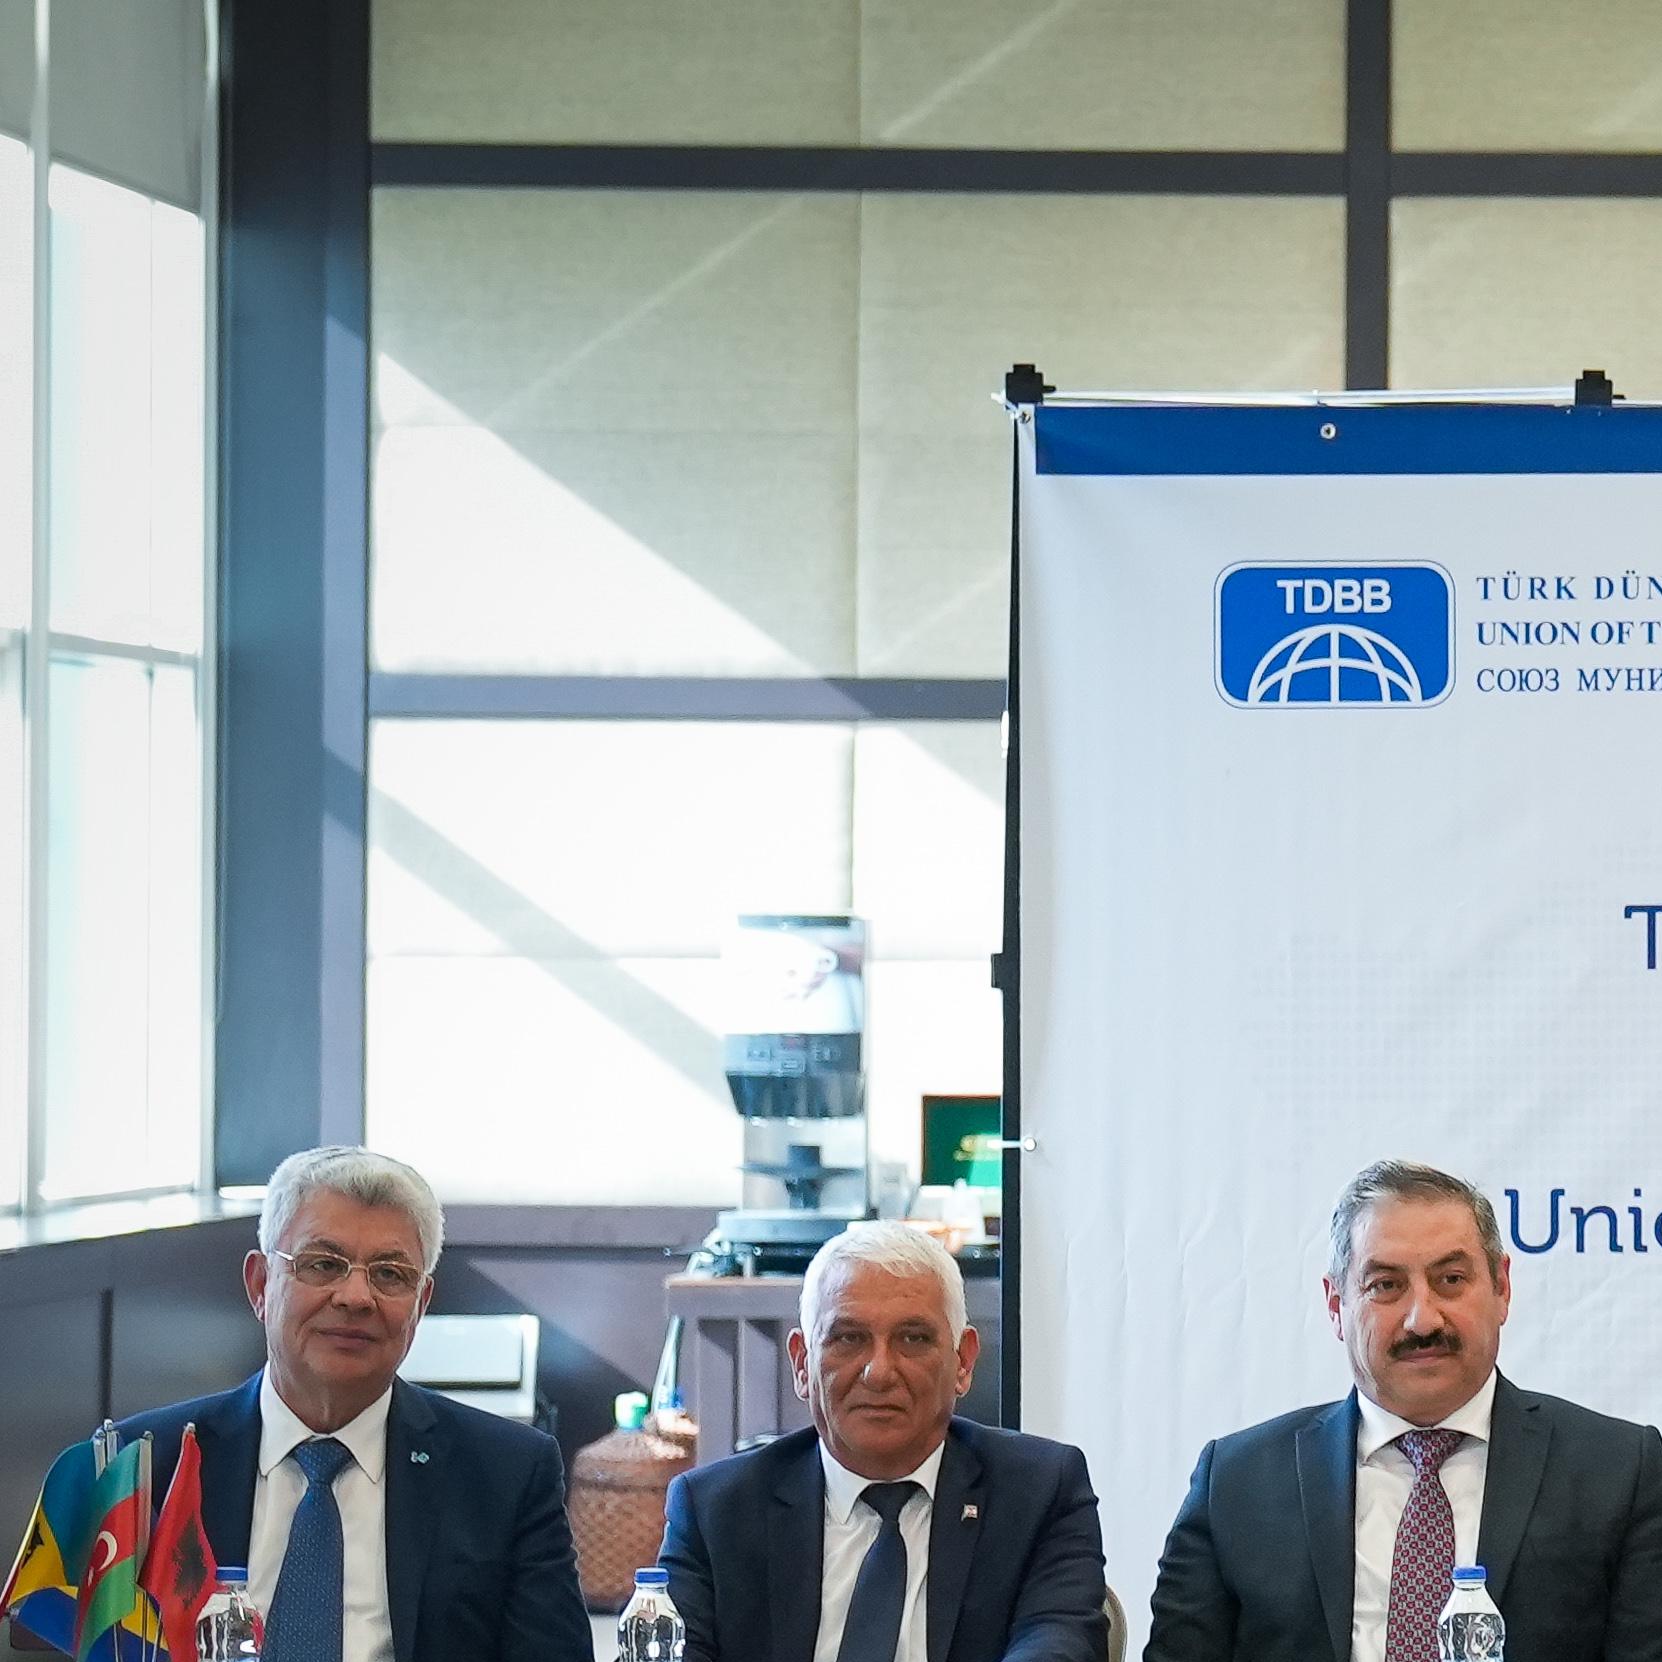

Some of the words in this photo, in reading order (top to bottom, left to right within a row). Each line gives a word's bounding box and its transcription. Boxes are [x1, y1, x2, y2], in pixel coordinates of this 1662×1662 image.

[1277, 579, 1391, 613] TDBB
[1477, 571, 1575, 600] TÜRK
[1478, 622, 1579, 645] UNION
[1591, 622, 1633, 644] OF
[1477, 669, 1559, 692] СОЮЗ
